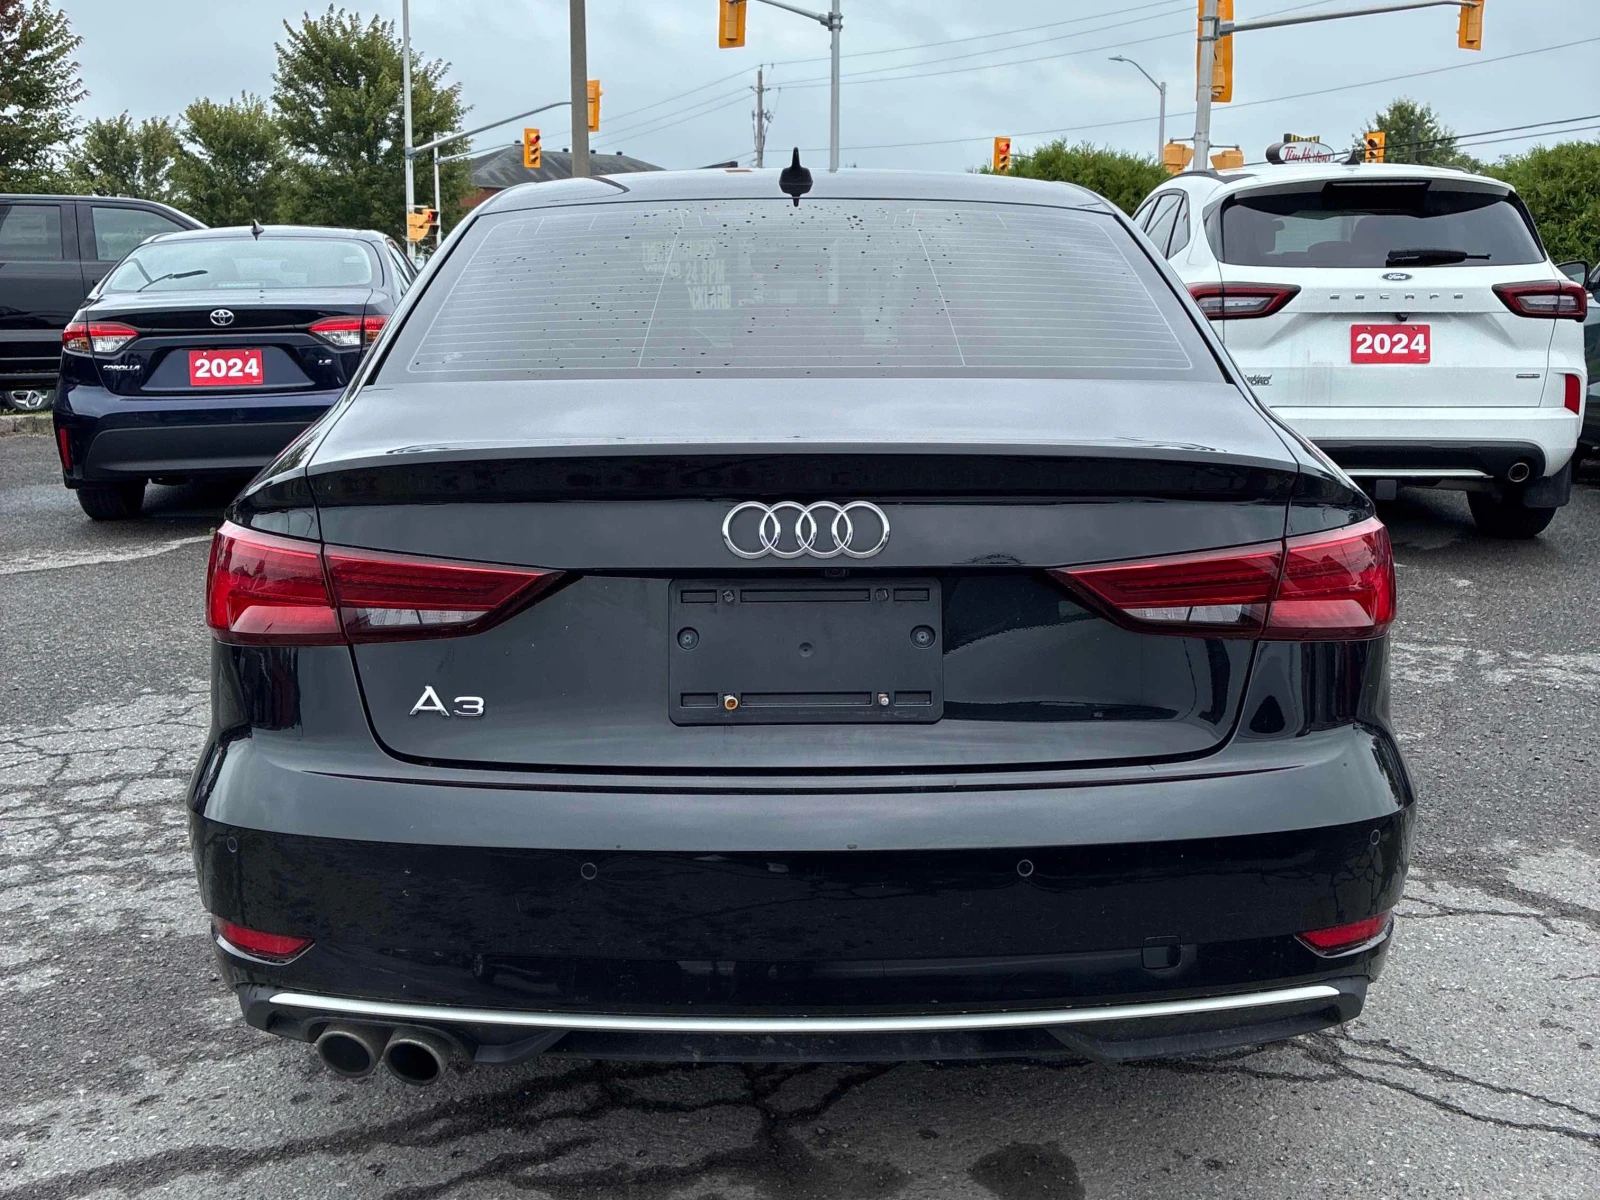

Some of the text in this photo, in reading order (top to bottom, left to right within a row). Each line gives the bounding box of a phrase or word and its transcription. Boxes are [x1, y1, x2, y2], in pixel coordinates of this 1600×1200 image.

[1356, 333, 1427, 354] 2024
[194, 358, 259, 378] 2024
[409, 685, 485, 717] A3
